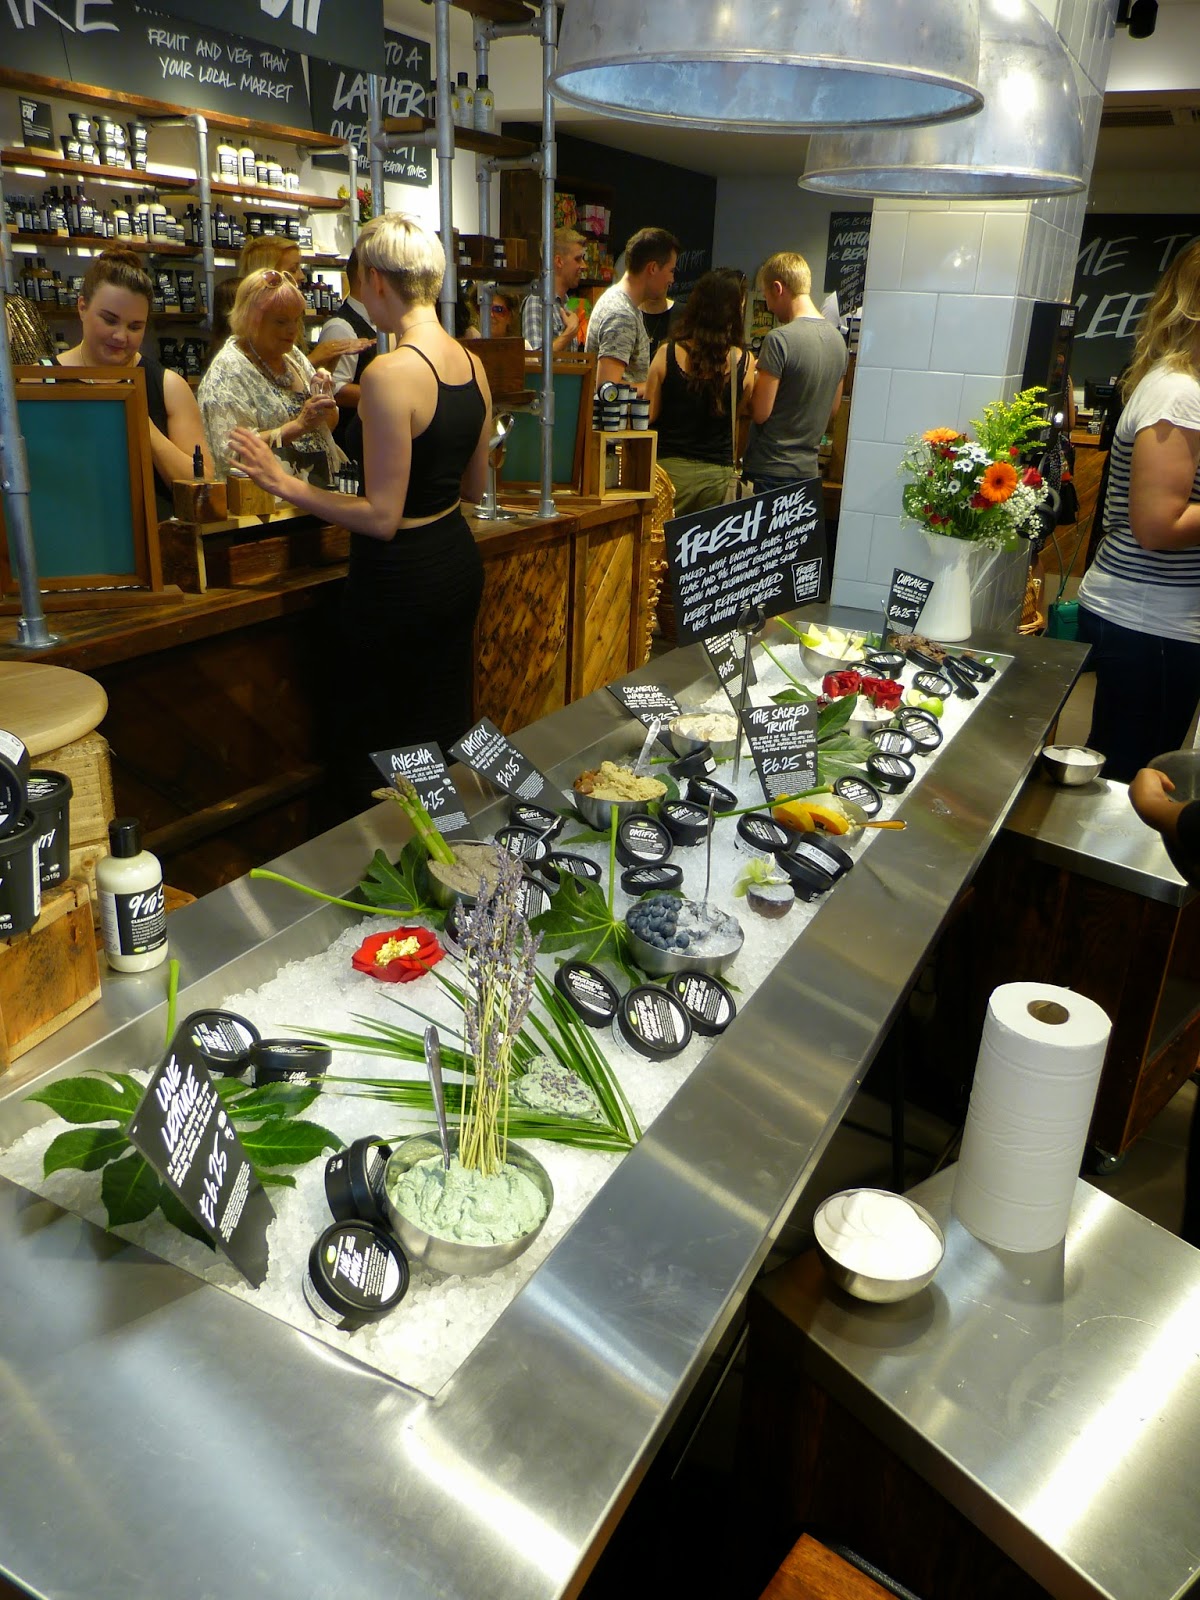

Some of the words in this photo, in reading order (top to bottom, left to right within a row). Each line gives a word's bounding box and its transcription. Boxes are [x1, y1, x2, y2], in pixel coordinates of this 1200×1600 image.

[148, 28, 190, 52] FRUIT
[196, 39, 222, 61] AND
[226, 45, 253, 69] VEG
[260, 52, 289, 73] THAN
[384, 41, 403, 66] TO
[405, 46, 423, 72] A
[159, 57, 194, 79] YOUR
[199, 66, 236, 89] LOCAL
[240, 73, 294, 104] MARKET
[332, 71, 426, 118] LAHER
[407, 164, 427, 180] TIMES
[828, 251, 840, 261] AS
[675, 500, 767, 568] FRESH
[772, 486, 806, 515] FACE
[768, 501, 817, 533] MASKS
[679, 567, 706, 585] PACKED
[701, 574, 716, 587] AND
[795, 561, 817, 577] FREE
[896, 573, 929, 591] CUPCAKE
[682, 602, 713, 625] KEEP
[714, 572, 784, 612] REFRIGERATED
[704, 586, 720, 599] AND
[692, 617, 709, 632] USE
[710, 604, 737, 624] WITHIN
[751, 585, 783, 606] WEEKS
[622, 685, 659, 694] COSMETIC
[749, 709, 769, 724] THE
[771, 704, 809, 720] SACRED
[764, 718, 799, 734] TRUTH
[460, 724, 493, 757] OATIFIX
[391, 748, 436, 771] AYESHA
[496, 757, 520, 788] £6.25
[762, 753, 802, 774] £6.25
[421, 787, 445, 812] 6.25
[629, 828, 659, 840] OATIFIX
[129, 893, 145, 918] 9
[141, 891, 158, 915] TO
[156, 1054, 183, 1112] LOVE
[160, 1064, 199, 1153] LETTUCE
[198, 1131, 228, 1228] £6.25
